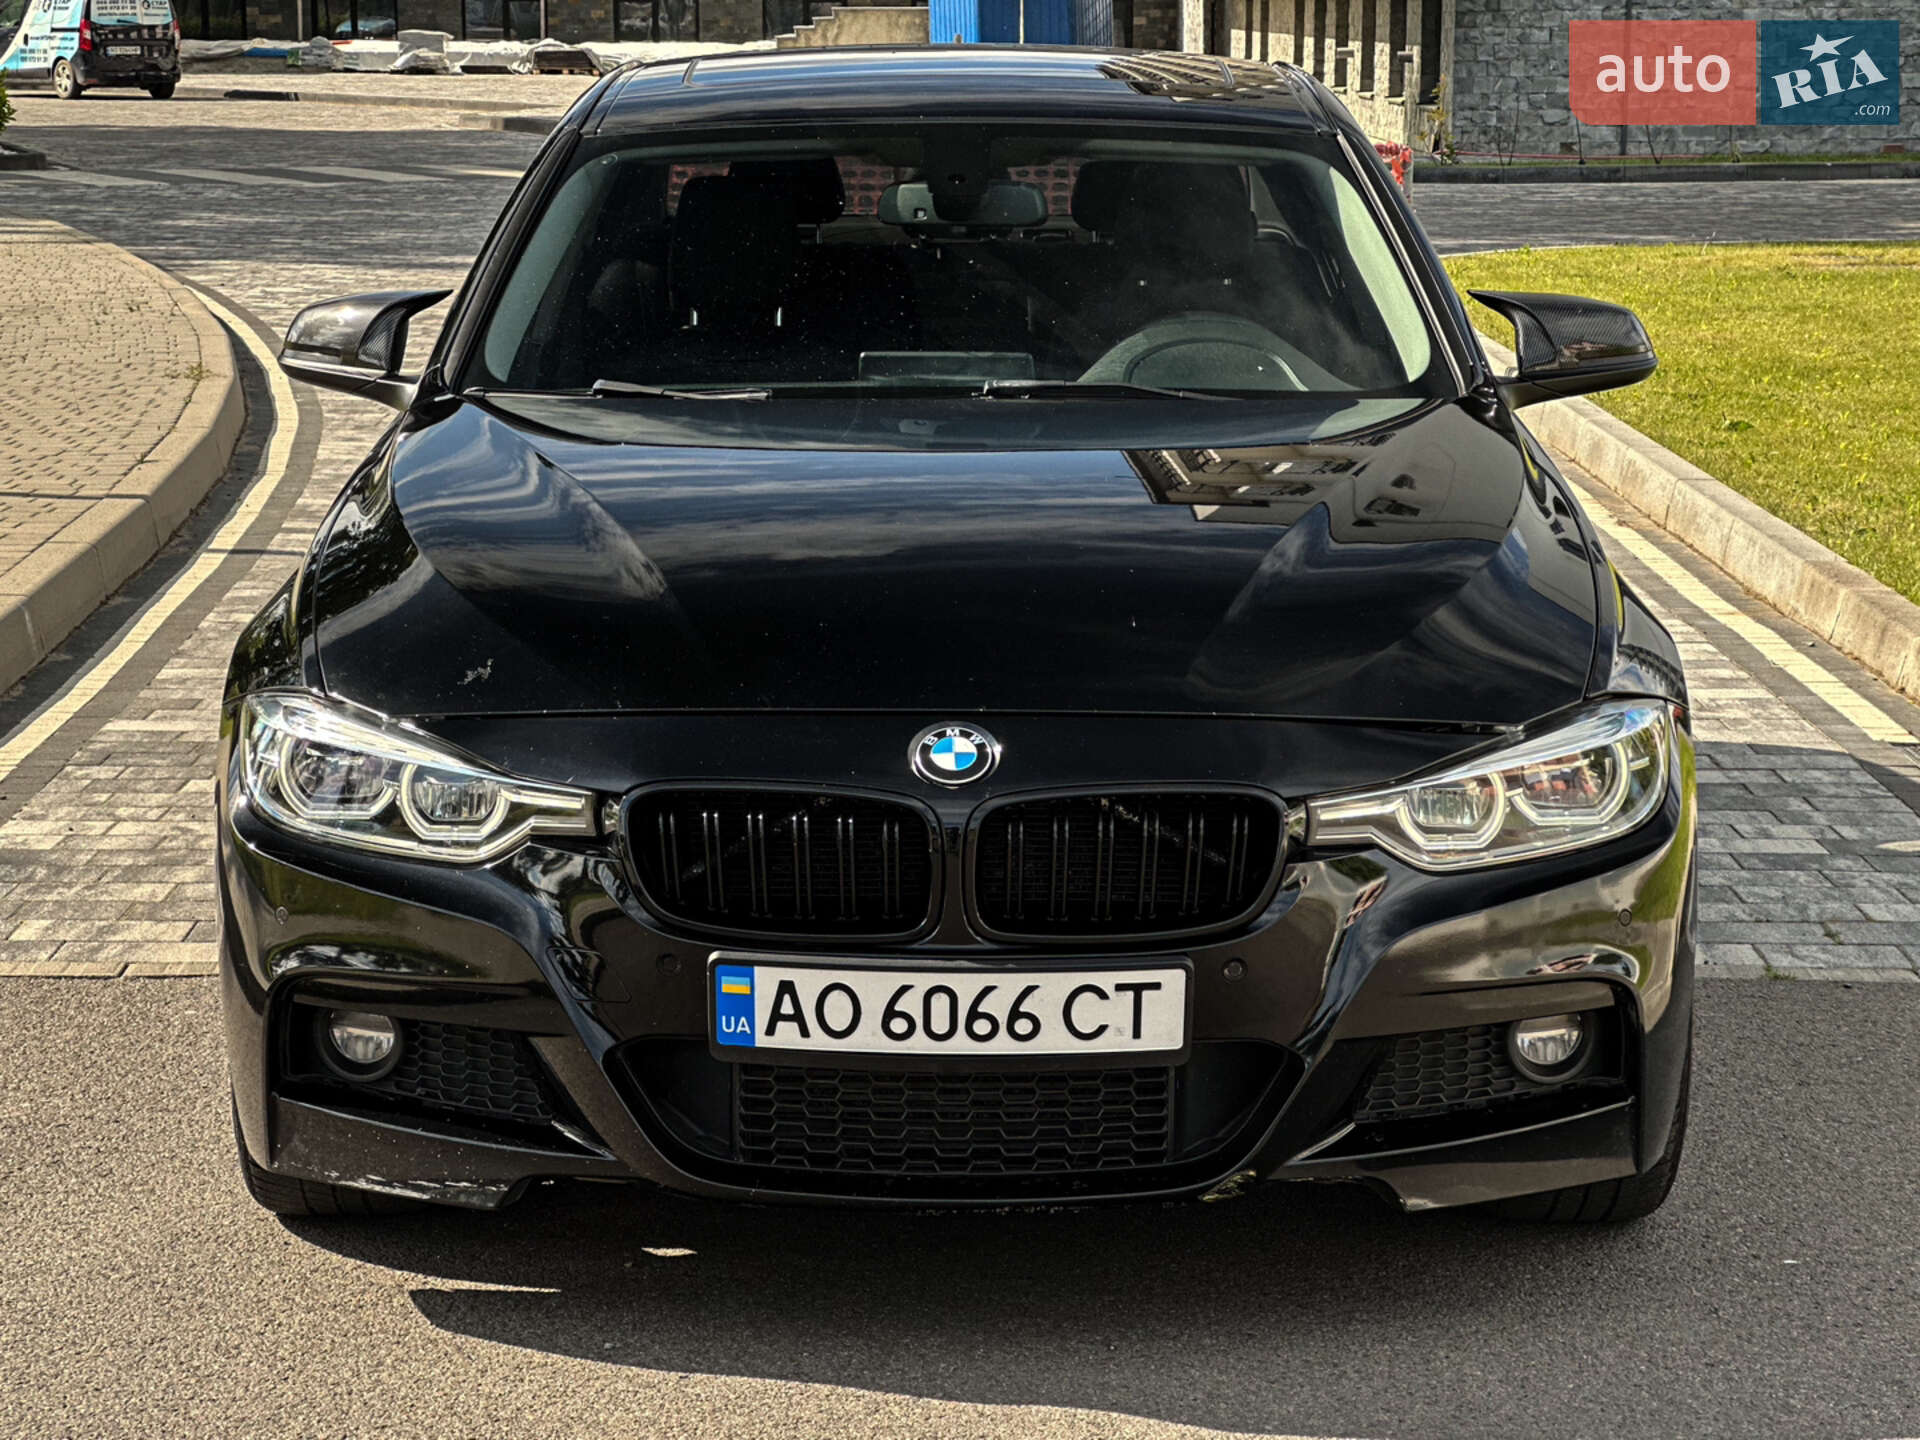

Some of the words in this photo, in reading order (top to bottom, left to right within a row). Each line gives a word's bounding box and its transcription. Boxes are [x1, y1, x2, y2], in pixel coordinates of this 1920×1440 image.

[923, 728, 985, 746] BMW
[764, 980, 862, 1040] AO
[880, 984, 1042, 1043] 6066
[1062, 981, 1162, 1041] CT
[721, 1016, 751, 1034] UA
